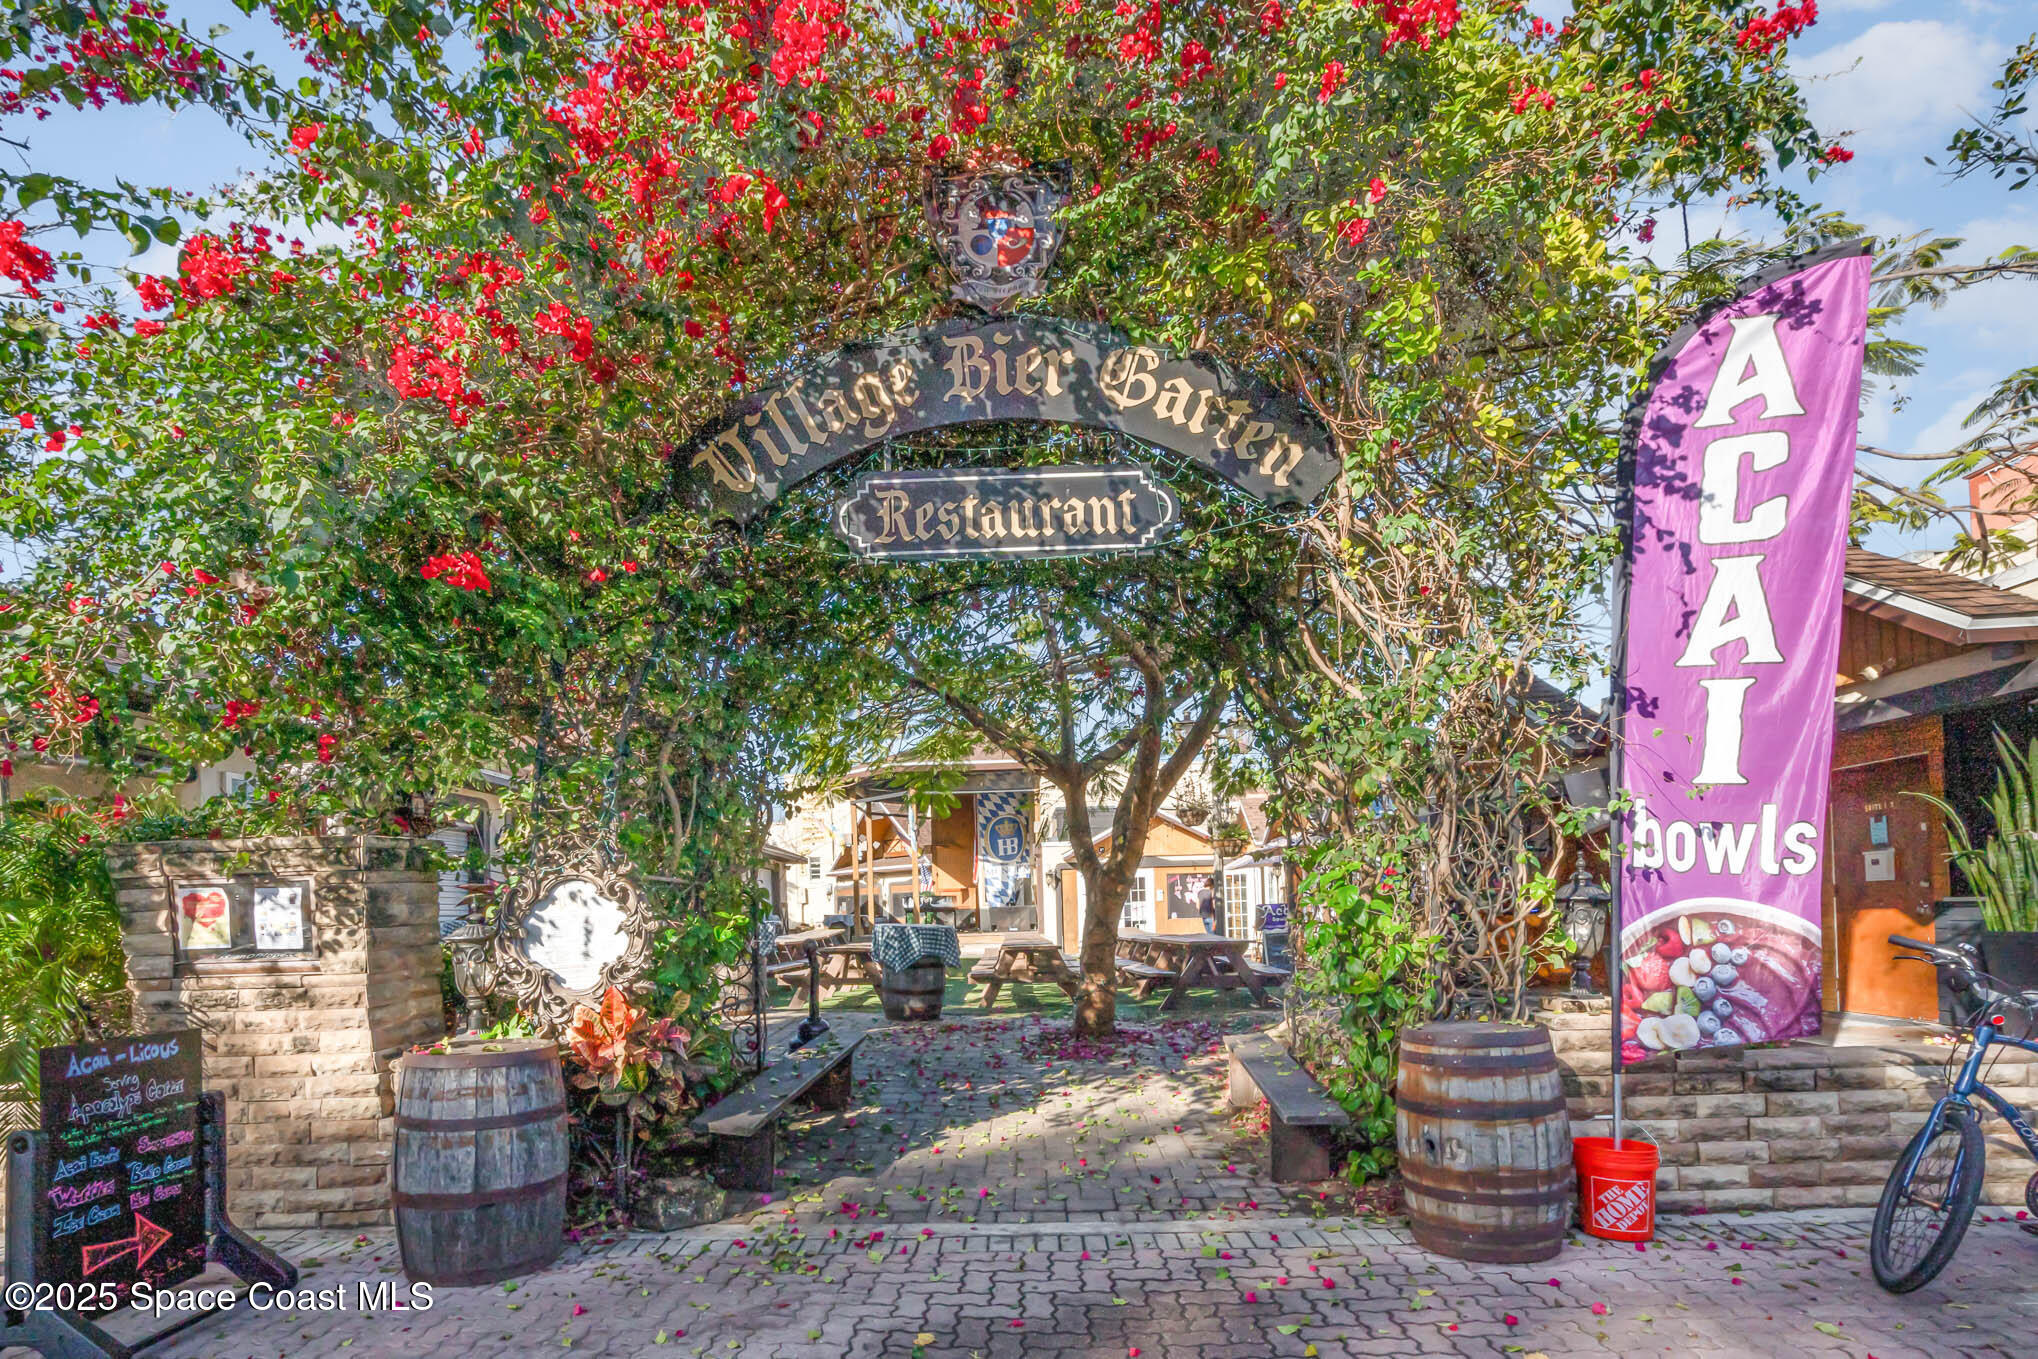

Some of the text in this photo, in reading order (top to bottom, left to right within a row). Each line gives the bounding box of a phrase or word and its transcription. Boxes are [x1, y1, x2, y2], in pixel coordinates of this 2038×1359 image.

[692, 331, 1304, 493] Village Bier Garten
[873, 486, 1138, 546] Restaurant
[1674, 312, 1806, 785] ACAI
[1631, 798, 1819, 876] bowls
[1594, 1181, 1649, 1228] HOME
[1598, 1186, 1624, 1204] THE
[1616, 1201, 1648, 1230] DEPOT
